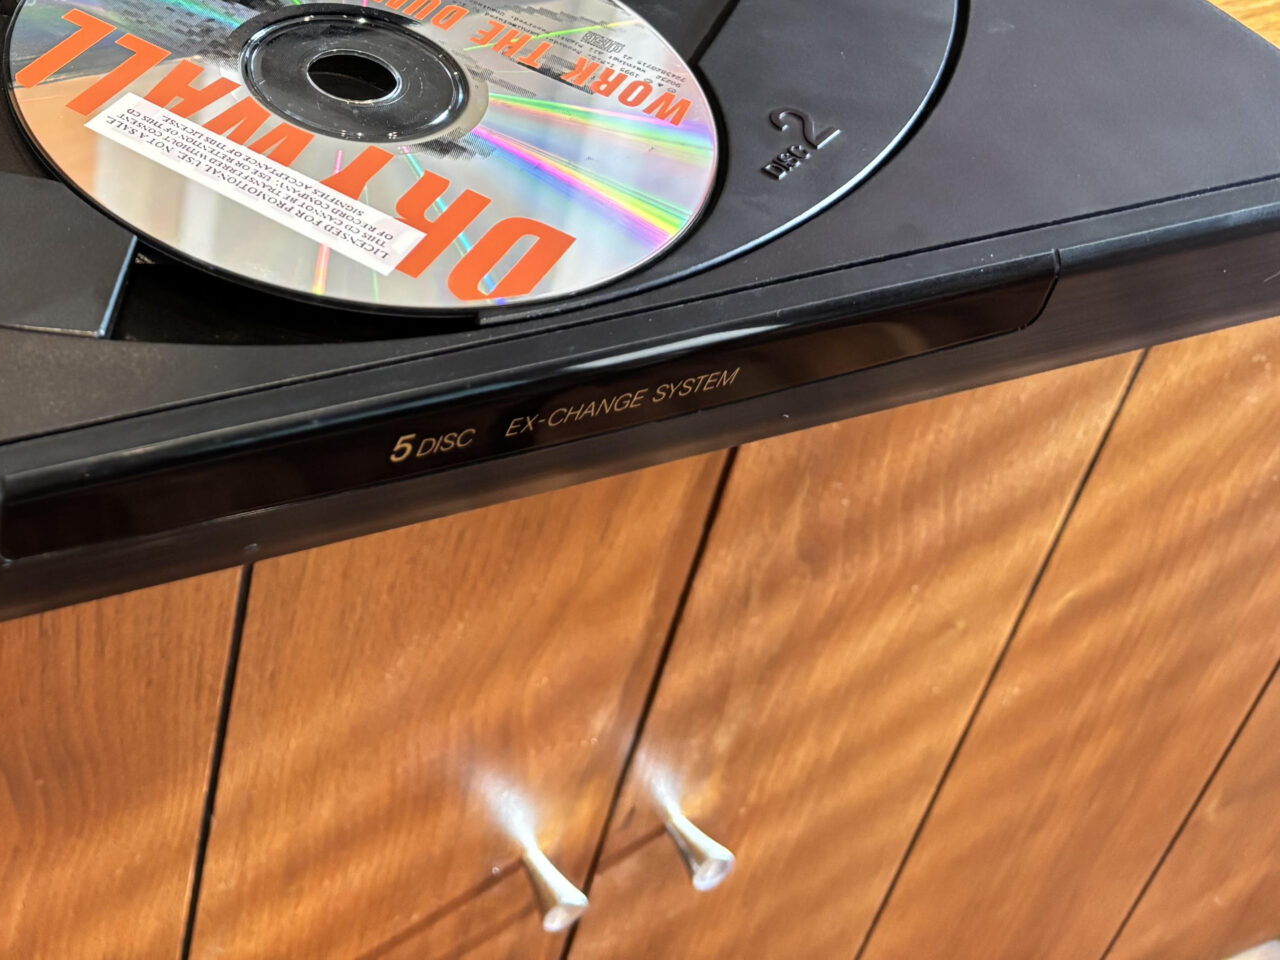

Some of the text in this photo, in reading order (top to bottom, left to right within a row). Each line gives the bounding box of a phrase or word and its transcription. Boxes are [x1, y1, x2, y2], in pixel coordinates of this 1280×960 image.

[468, 19, 554, 68] THE
[559, 58, 694, 127] WORK
[102, 114, 139, 135] SALE.
[125, 106, 141, 117] CD
[140, 114, 163, 128] THIS
[161, 124, 179, 136] OF
[768, 107, 842, 149] 2
[146, 136, 174, 153] NOT
[178, 132, 236, 162] RETENTION
[158, 114, 365, 216] SIGNIFIES ACCEPTANCE OF THIS LICENSE.
[174, 150, 202, 166] USE.
[233, 160, 251, 171] OR
[761, 144, 812, 181] DISC
[115, 111, 387, 247] THIS CD CANNOT BE TRANSFERRED WITHOUT CONSENT
[250, 167, 272, 181] USE
[200, 164, 295, 212] PROMOTIONAL
[293, 208, 323, 226] FOR
[329, 206, 377, 232] RECORD
[321, 223, 390, 259] LICENSED
[377, 229, 394, 240] OF
[389, 367, 741, 463] 5 DISC EX-CHANGE SYSTEM
